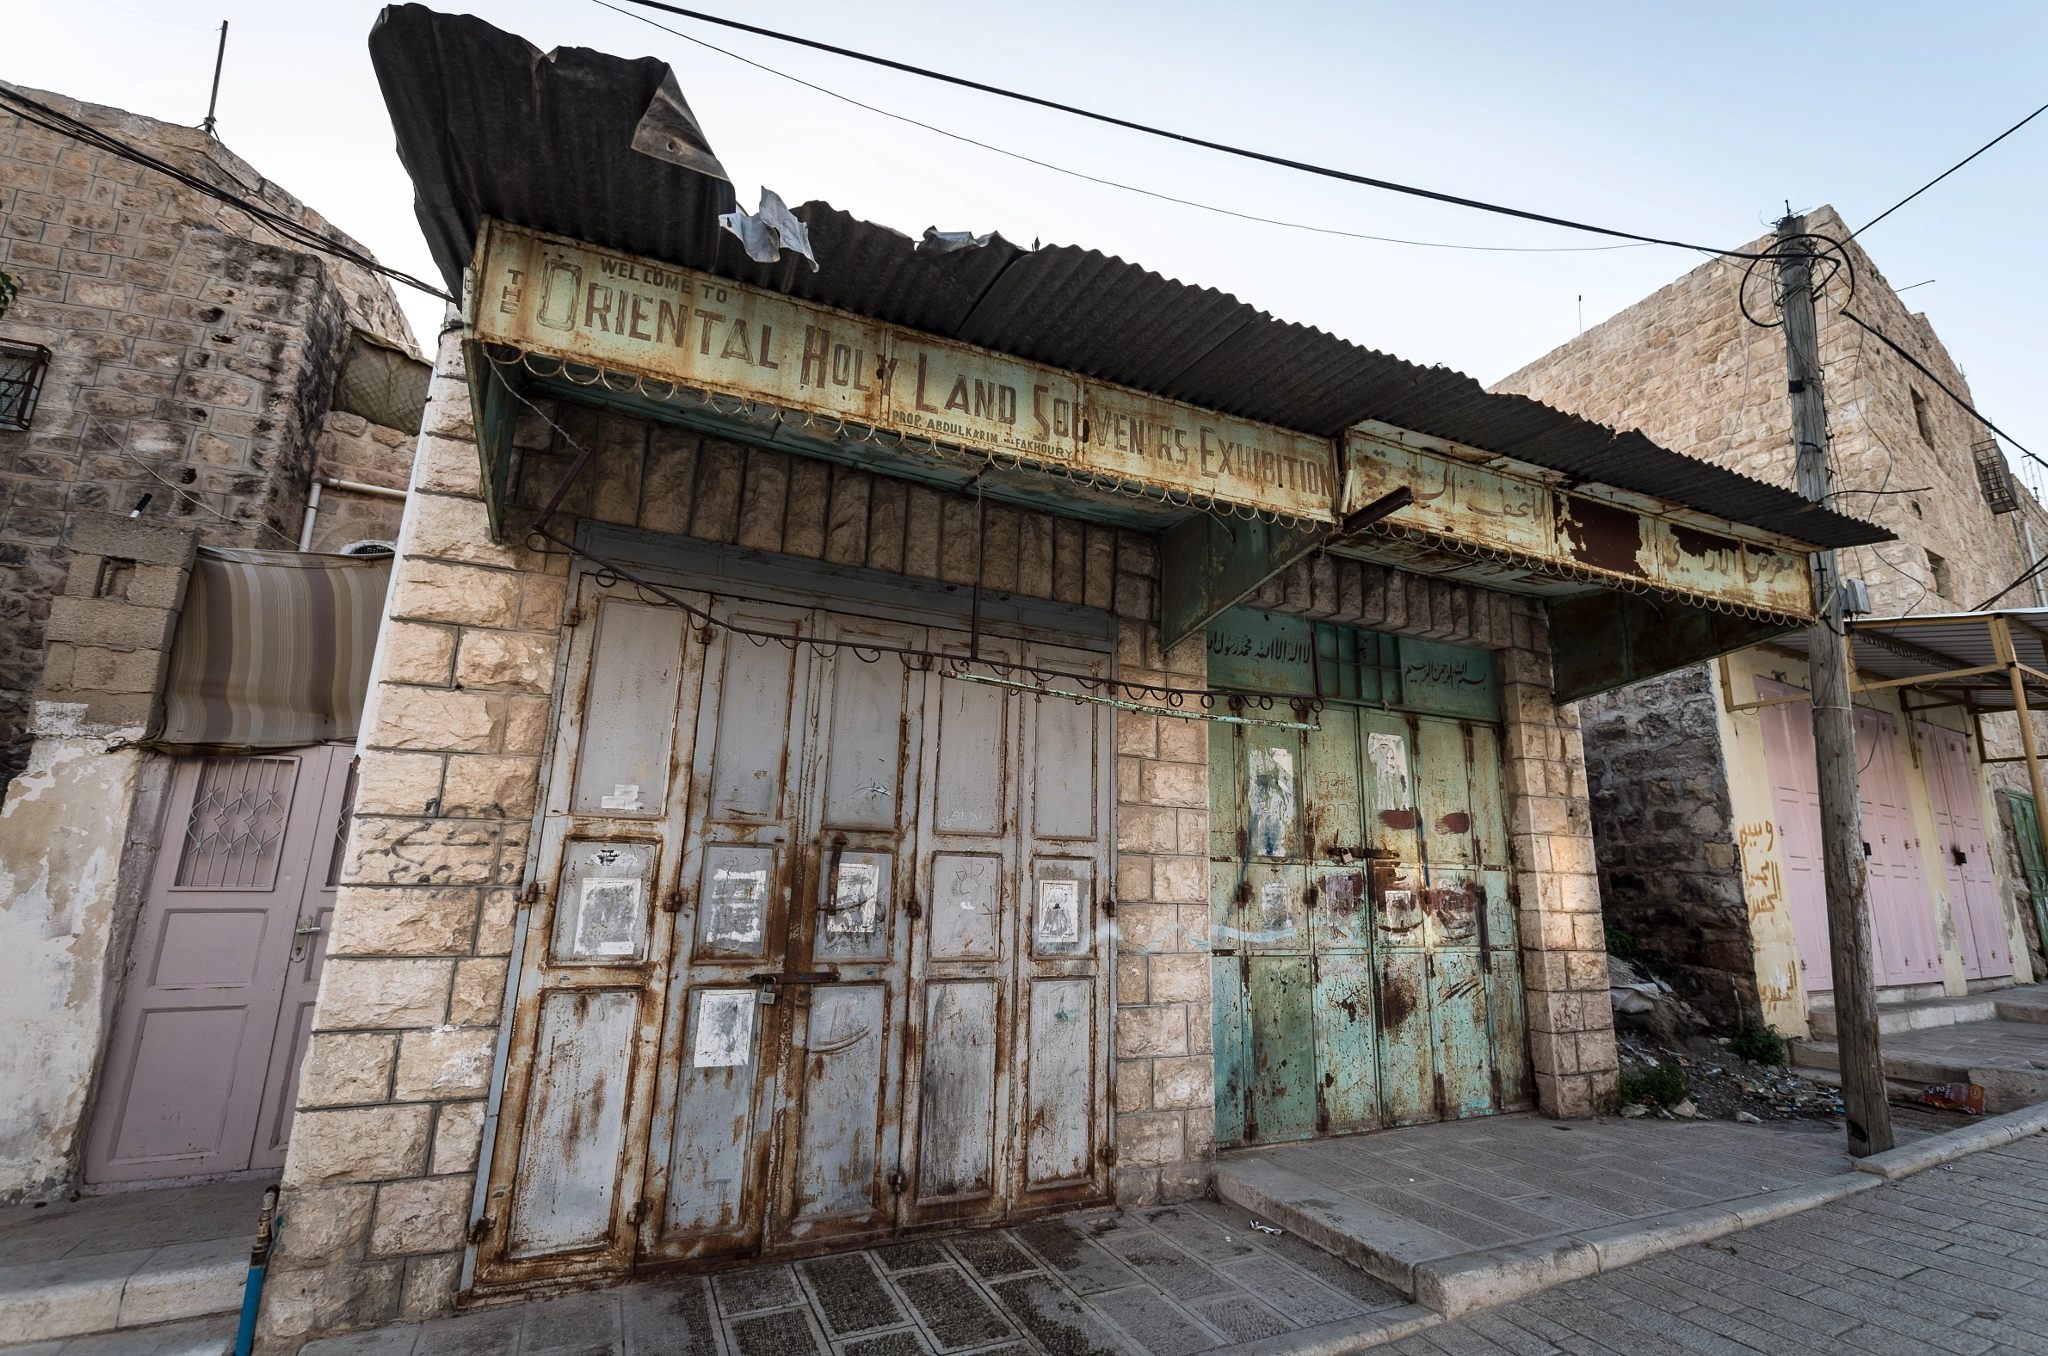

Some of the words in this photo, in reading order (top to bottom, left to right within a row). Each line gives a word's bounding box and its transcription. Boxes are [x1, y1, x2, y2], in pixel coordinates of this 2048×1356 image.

[499, 268, 525, 317] THE
[600, 257, 692, 294] WELCOME
[700, 283, 728, 304] TO
[536, 257, 779, 370] ORIENTAL
[800, 324, 898, 396] HOLY
[915, 352, 1017, 426] LAND
[1032, 384, 1189, 466] SOUVENIRS
[1199, 425, 1335, 499] EXHIBITION
[892, 409, 922, 427] PROP.
[926, 418, 998, 443] ABDULKARIM
[1015, 438, 1072, 459] FAKHOURY
